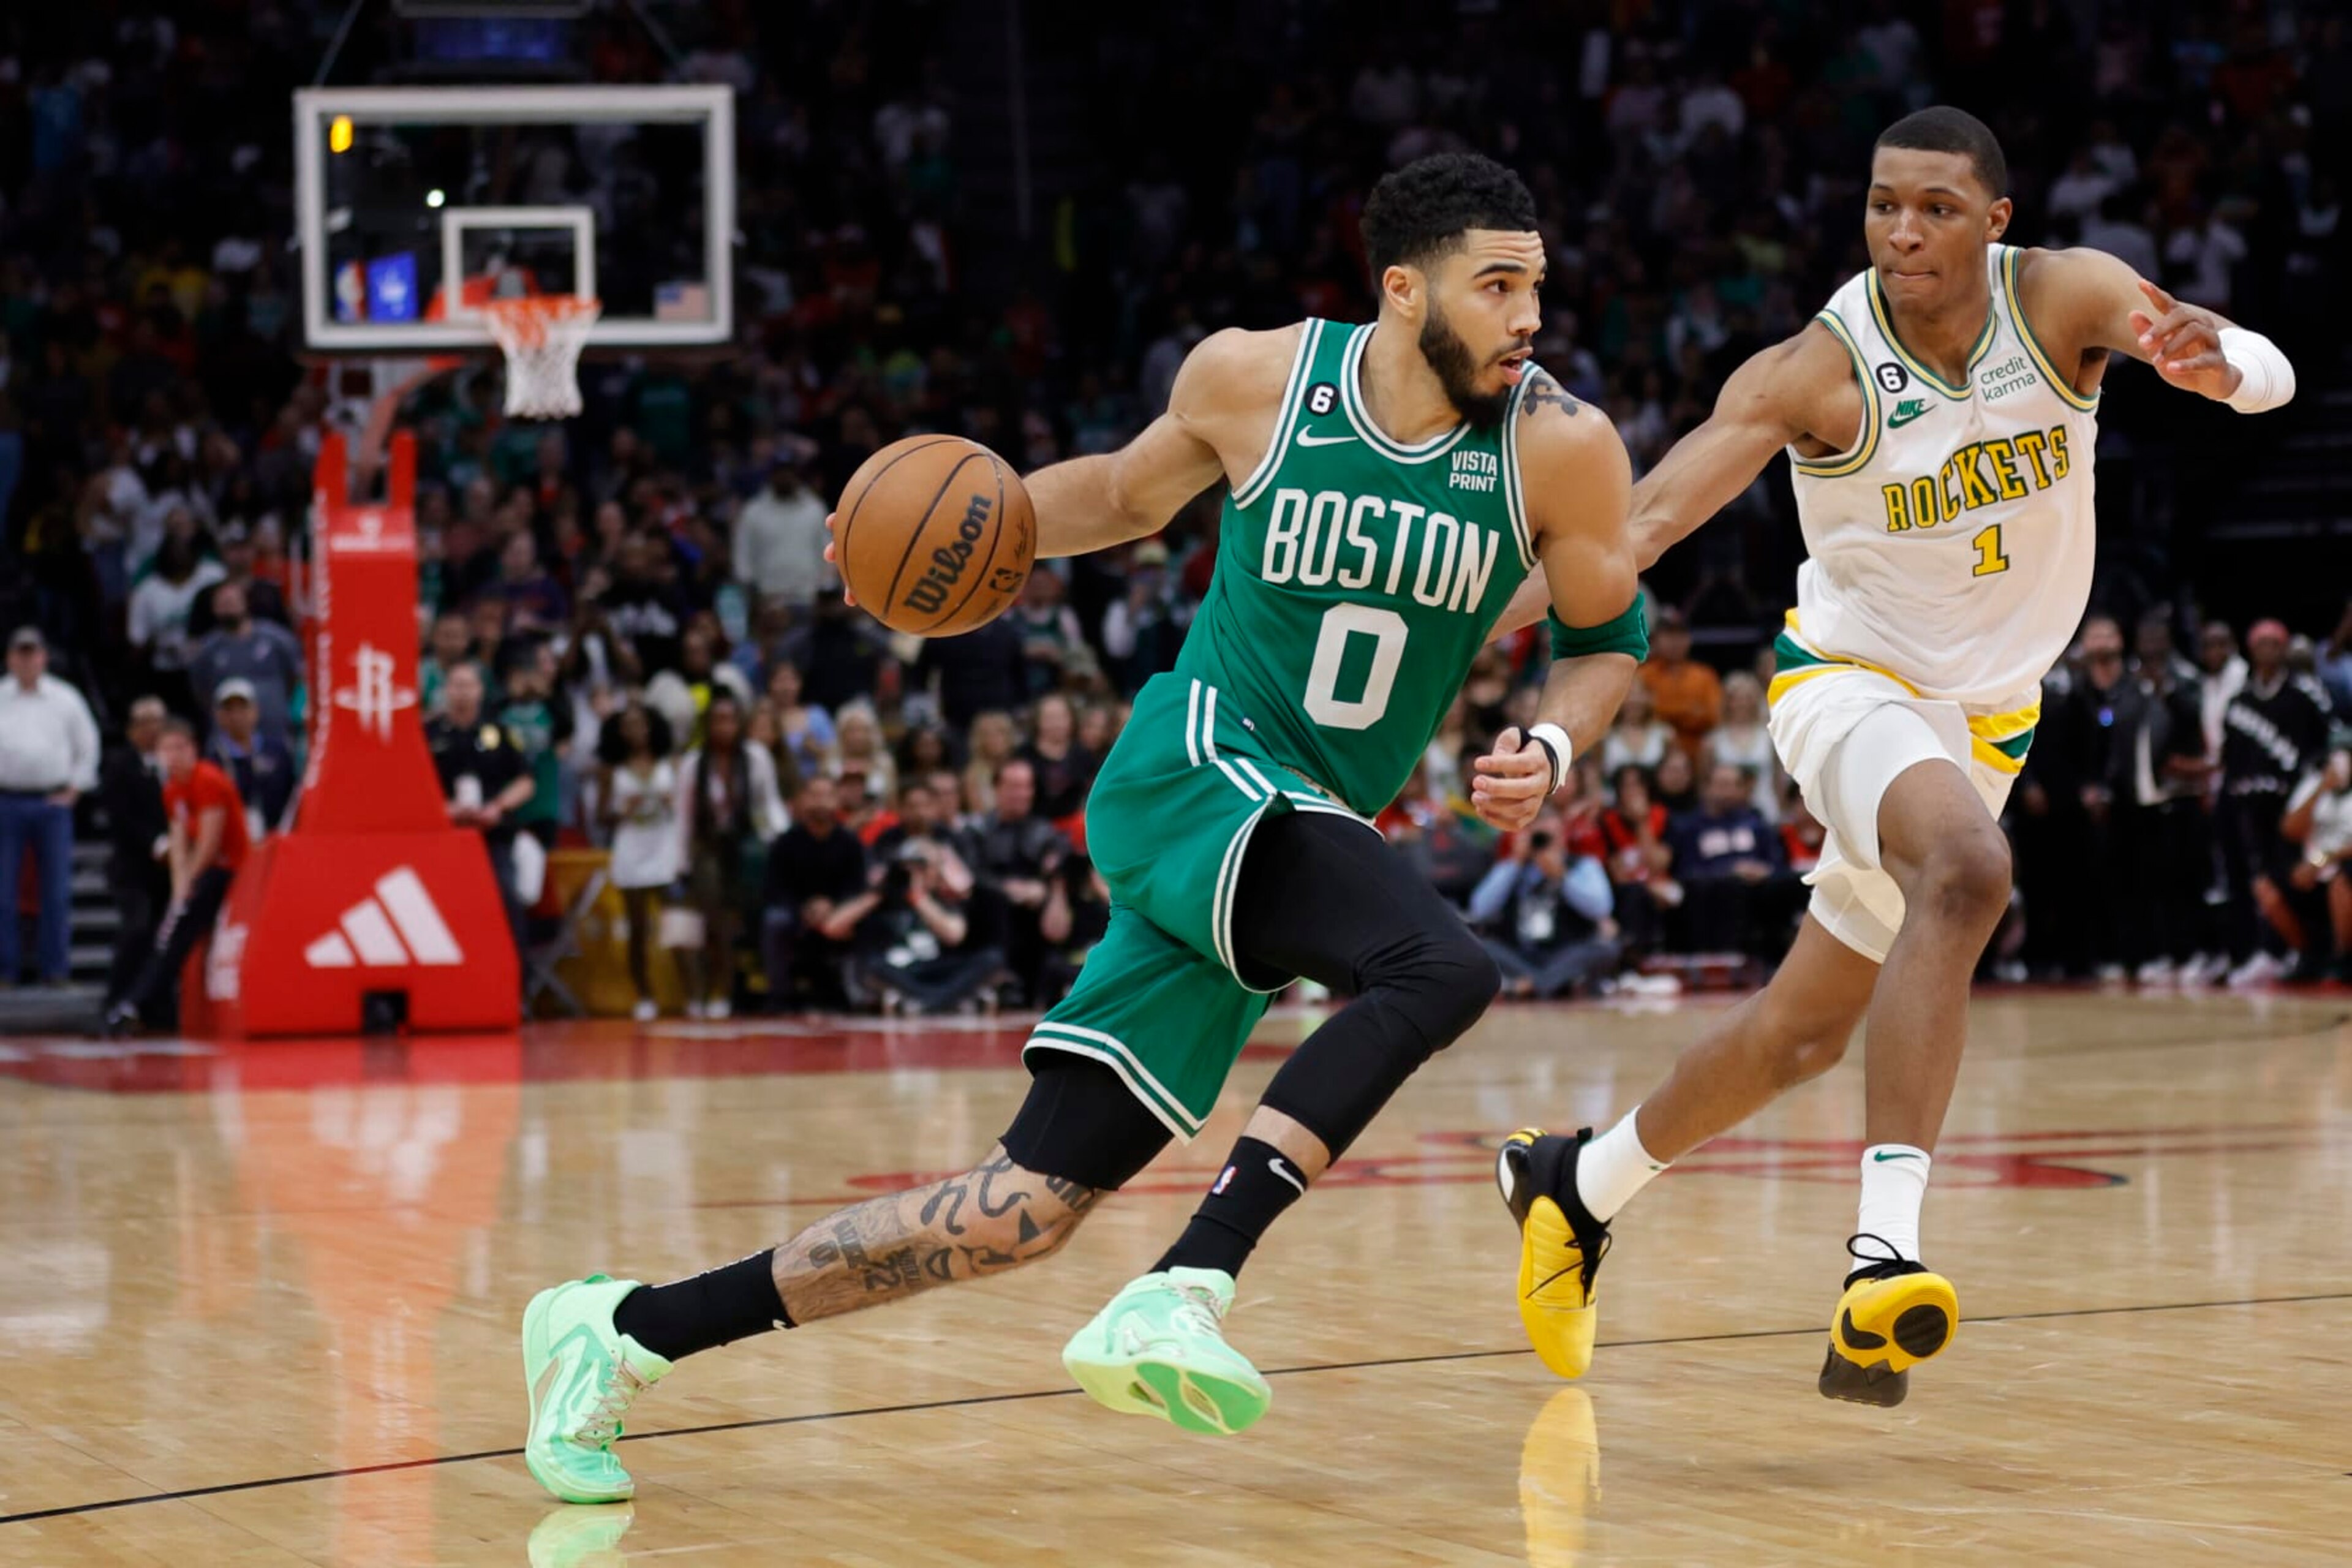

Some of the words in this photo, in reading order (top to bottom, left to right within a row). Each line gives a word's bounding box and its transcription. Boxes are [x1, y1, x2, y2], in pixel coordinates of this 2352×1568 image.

[1881, 366, 1902, 391] 6
[1980, 356, 2027, 385] credit
[1311, 385, 1334, 413] 6
[1981, 372, 2037, 402] karma
[1895, 398, 1926, 417] NIKE
[1452, 450, 1498, 477] VISTA
[1449, 472, 1498, 492] PRINT
[1882, 425, 2070, 532] ROCKETS
[905, 495, 992, 613] Wilson
[1262, 488, 1501, 613] BOSTON
[1972, 524, 2010, 577] 1
[1303, 602, 1409, 730] 0
